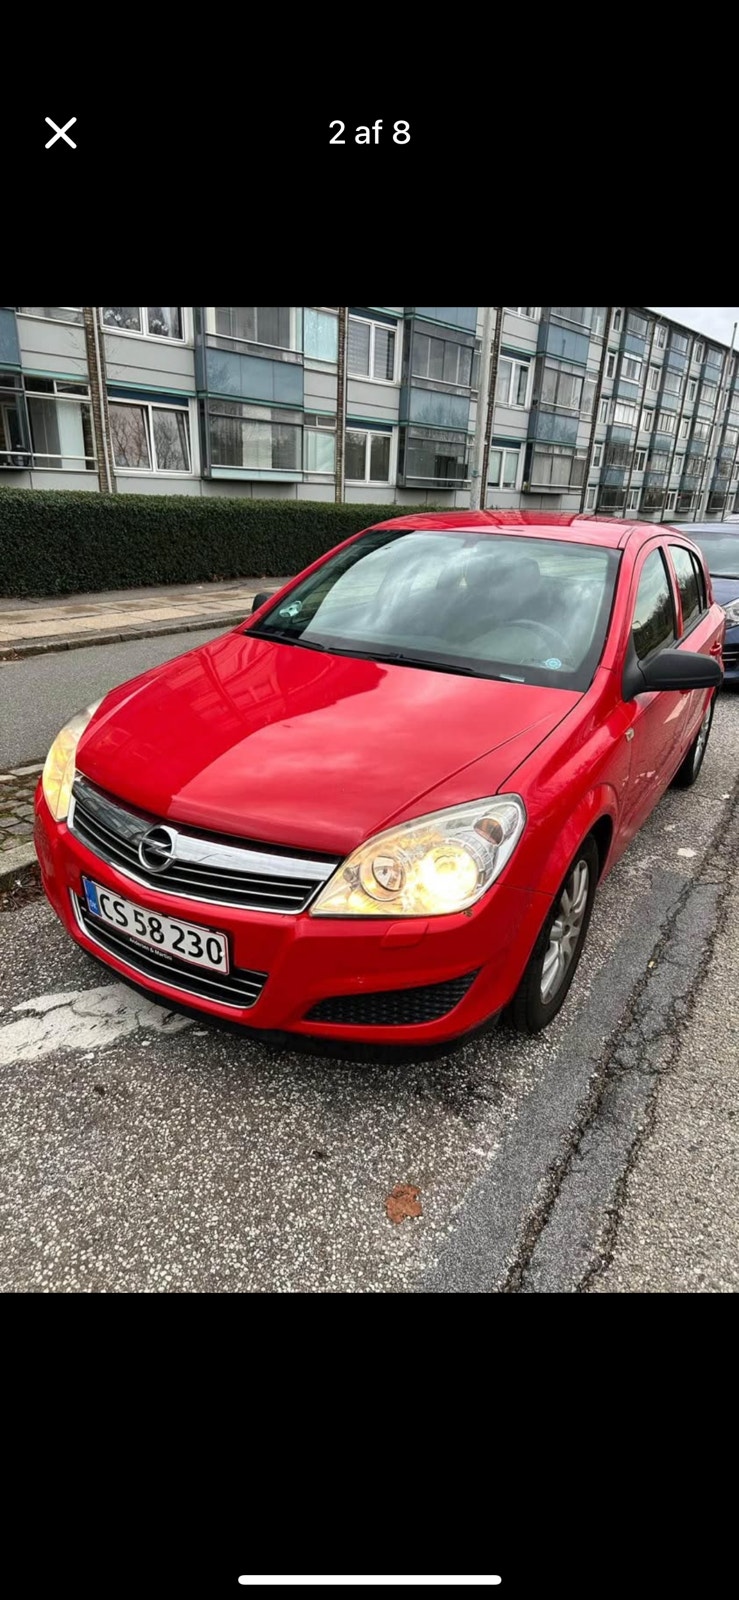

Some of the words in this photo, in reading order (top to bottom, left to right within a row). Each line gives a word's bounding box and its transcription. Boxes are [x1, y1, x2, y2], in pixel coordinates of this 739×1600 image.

[100, 894, 128, 927] CS
[133, 909, 165, 944] 58
[170, 925, 223, 965] 230
